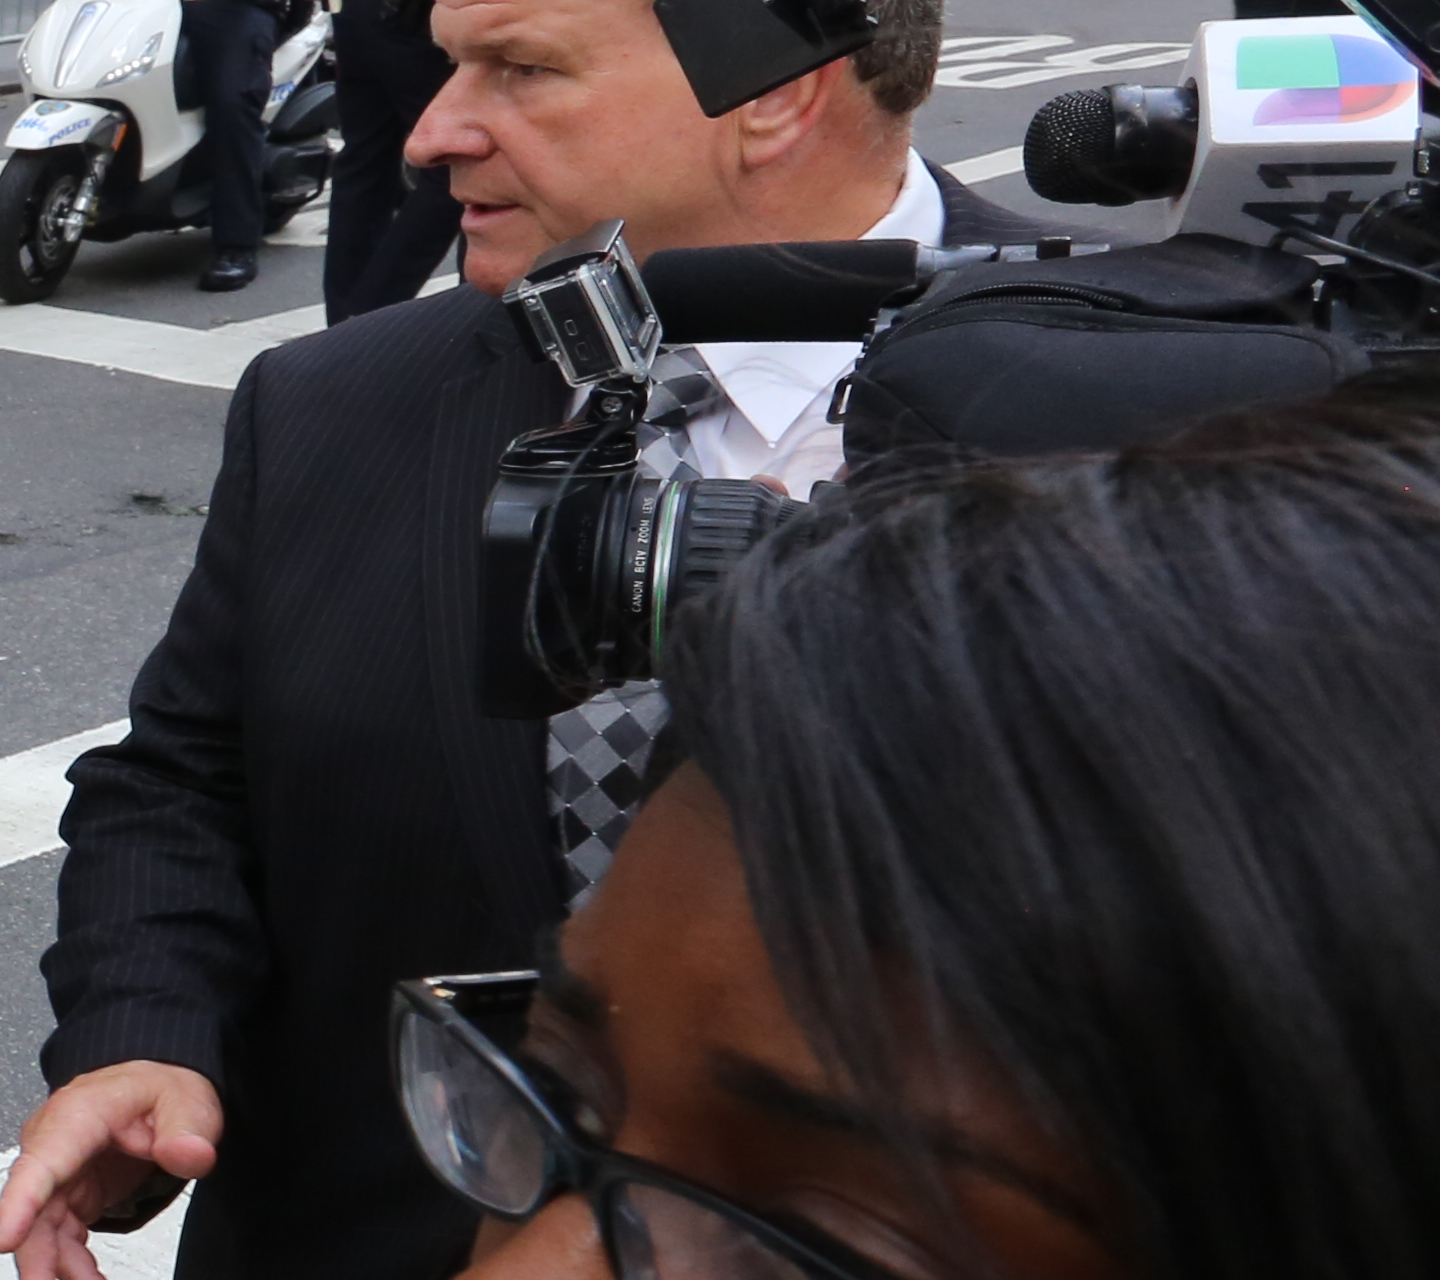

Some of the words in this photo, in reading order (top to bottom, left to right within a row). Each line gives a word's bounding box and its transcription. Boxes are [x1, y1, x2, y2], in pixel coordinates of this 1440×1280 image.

[48, 118, 92, 147] POLICE
[642, 497, 655, 514] LENS
[637, 519, 651, 544] ZOOM
[631, 580, 644, 613] CANON
